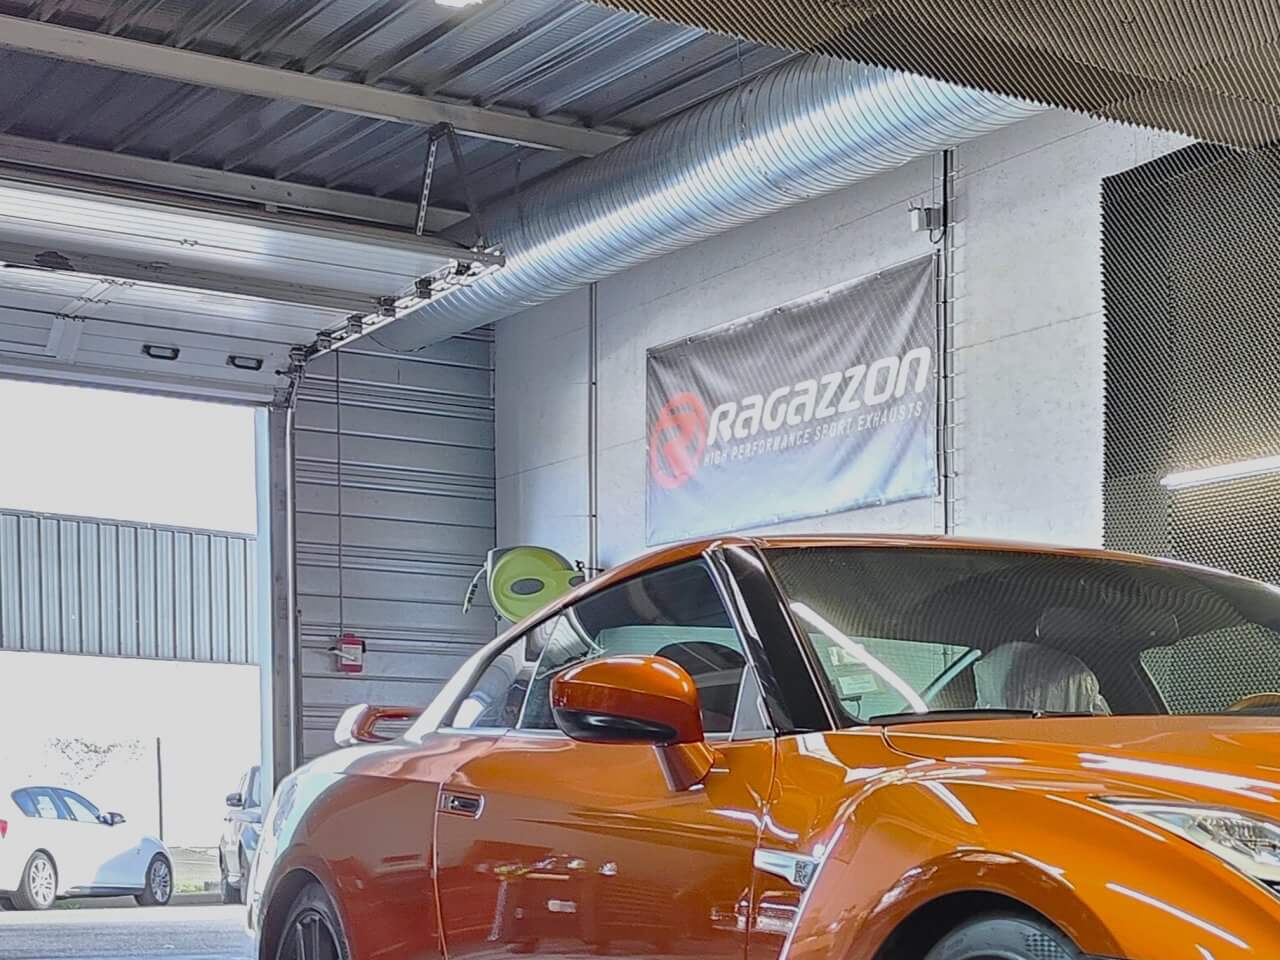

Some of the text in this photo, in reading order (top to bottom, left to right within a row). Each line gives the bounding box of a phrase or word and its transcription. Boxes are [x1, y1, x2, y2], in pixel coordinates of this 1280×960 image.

[730, 427, 810, 461] PERFORMANCE
[815, 417, 853, 441] SPORT
[857, 400, 923, 432] EXHAUSTS
